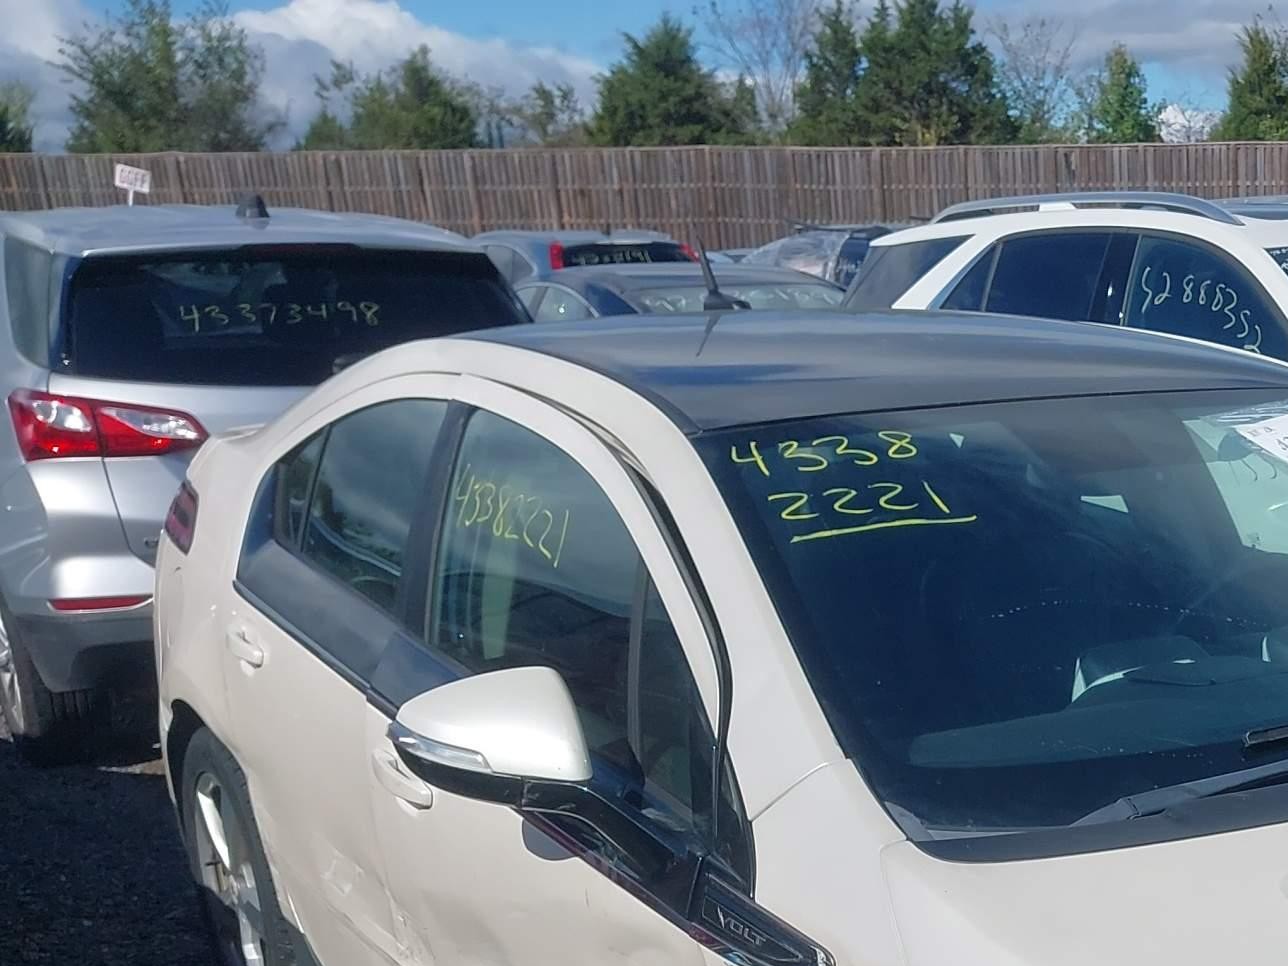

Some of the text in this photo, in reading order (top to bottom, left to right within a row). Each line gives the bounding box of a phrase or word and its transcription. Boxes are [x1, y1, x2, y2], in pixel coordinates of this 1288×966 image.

[179, 301, 380, 333] 43373498
[731, 431, 918, 476] 4338
[767, 480, 951, 520] 2221
[717, 905, 767, 946] VOLT
